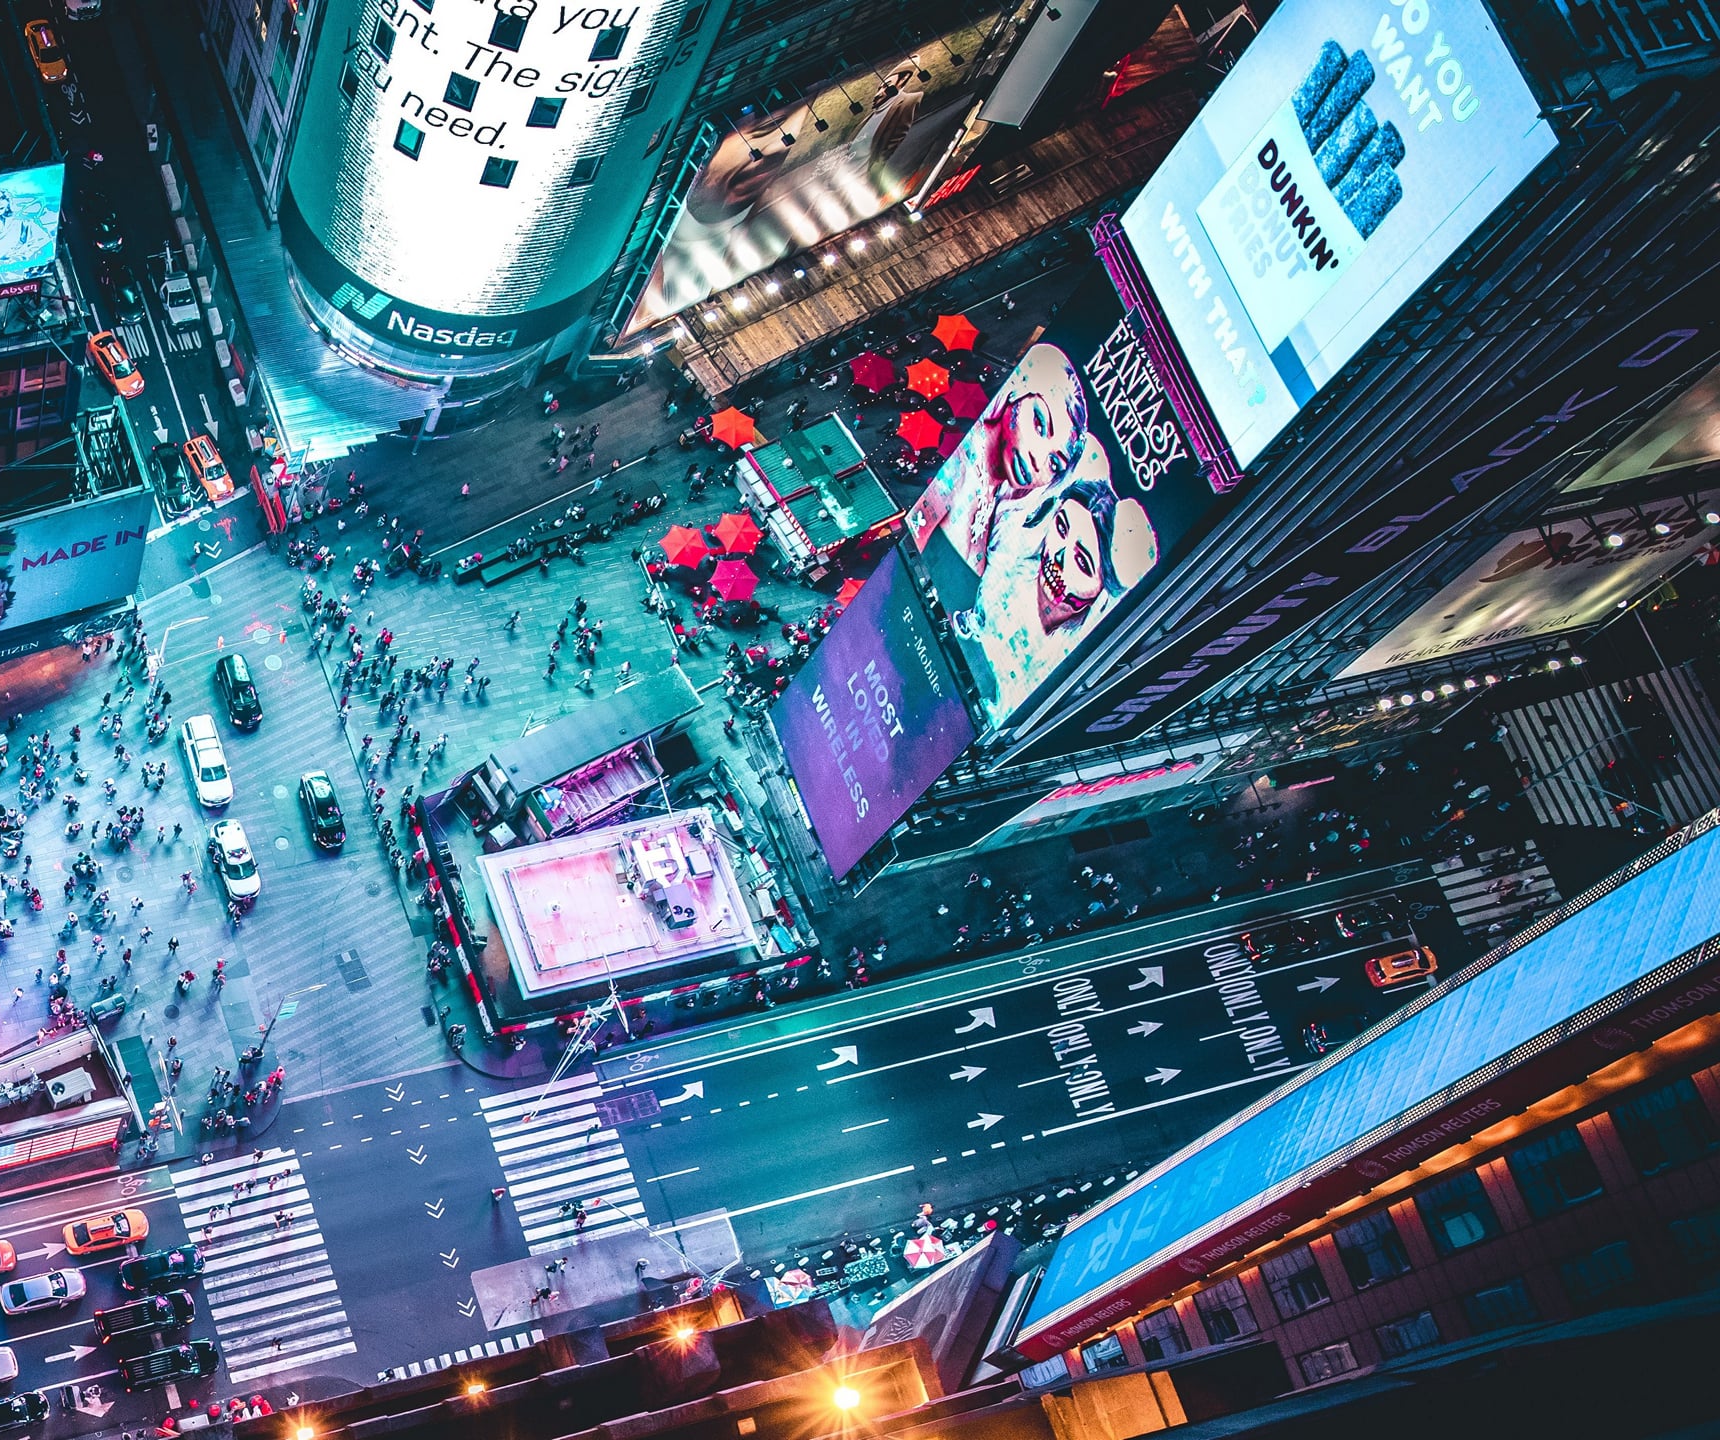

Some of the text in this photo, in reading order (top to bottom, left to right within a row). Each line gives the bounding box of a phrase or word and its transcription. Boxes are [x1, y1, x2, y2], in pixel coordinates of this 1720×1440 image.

[552, 3, 640, 35] you
[466, 40, 540, 88] The
[1370, 13, 1444, 133] WANT
[1425, 30, 1480, 123] YOU
[401, 90, 505, 149] need.
[1218, 185, 1273, 279] FRIES
[1238, 161, 1308, 279] DONUT
[1257, 138, 1339, 272] DUNKIN'
[1160, 201, 1212, 299] WITH
[0, 283, 37, 296] Absen
[387, 310, 518, 349] Nasdaq
[1083, 344, 1162, 491] MAKERS
[1104, 319, 1188, 474] FANTASY
[22, 525, 144, 571] MADE IN
[1085, 664, 1211, 733] CALL
[1191, 571, 1341, 657] DUTY
[1344, 386, 1618, 553] BLACK
[1385, 650, 1411, 664] WE
[1411, 641, 1451, 659] ARE
[1449, 633, 1483, 650] THE
[847, 671, 889, 764] LOVED
[863, 659, 904, 738] MOST
[844, 718, 864, 752] IN
[1203, 942, 1257, 981] ONLY
[1053, 977, 1104, 1016] ONLY
[1218, 980, 1270, 1024] ONLY
[1239, 1025, 1292, 1071] ONLY
[1382, 1098, 1502, 1163] THOMSON REUTERS
[1200, 1212, 1291, 1262] THOMSON REUTERS
[1060, 1298, 1132, 1336] THOMSON REUTERS
